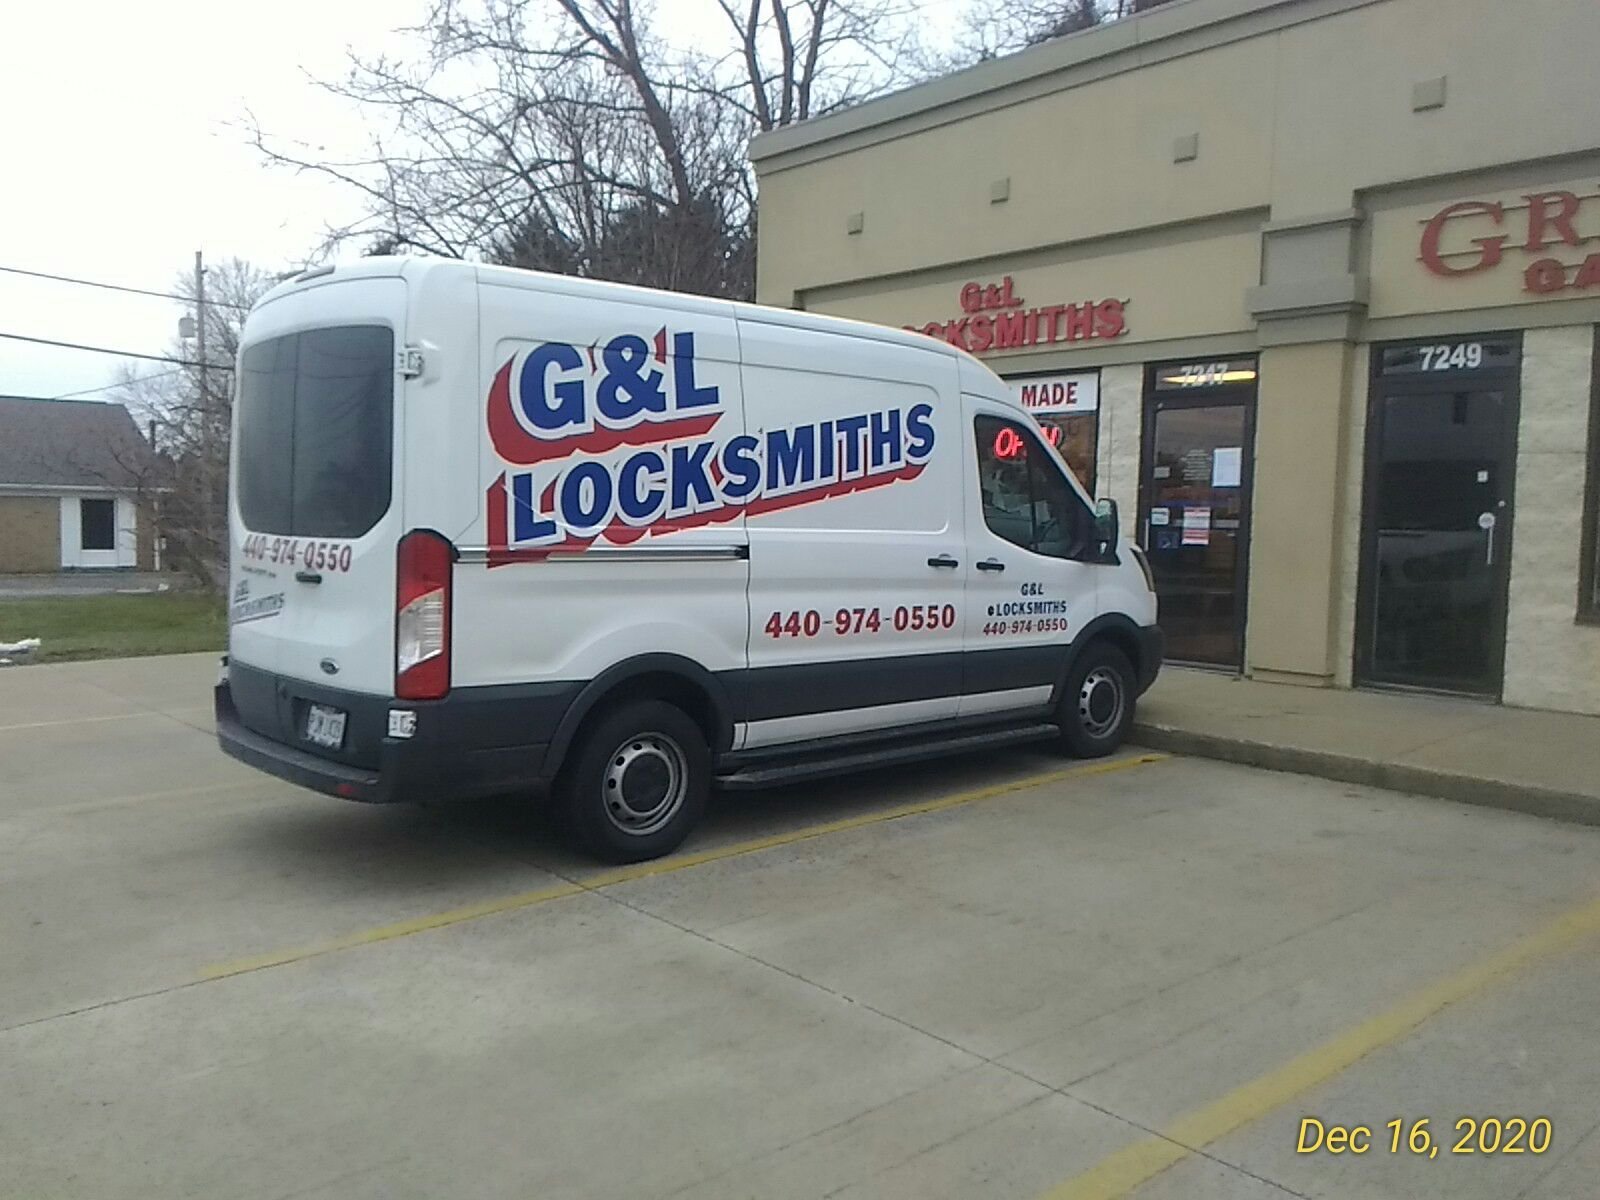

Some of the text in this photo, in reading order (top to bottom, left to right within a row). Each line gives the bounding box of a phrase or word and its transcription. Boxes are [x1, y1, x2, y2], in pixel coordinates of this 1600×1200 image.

[1420, 190, 1600, 278] GR
[960, 275, 1023, 313] G&L
[1419, 343, 1482, 371] 7249
[505, 328, 722, 440] G&L
[1180, 363, 1228, 387] 7247
[1021, 381, 1079, 407] MADE
[505, 402, 936, 548] LOCKSMITHS
[243, 534, 352, 573] 440-974-0550
[1021, 582, 1044, 596] G&L
[765, 603, 956, 639] 440-974-0550
[996, 600, 1067, 616] LOCKSMITHS
[983, 617, 1068, 636] 440-974-0550
